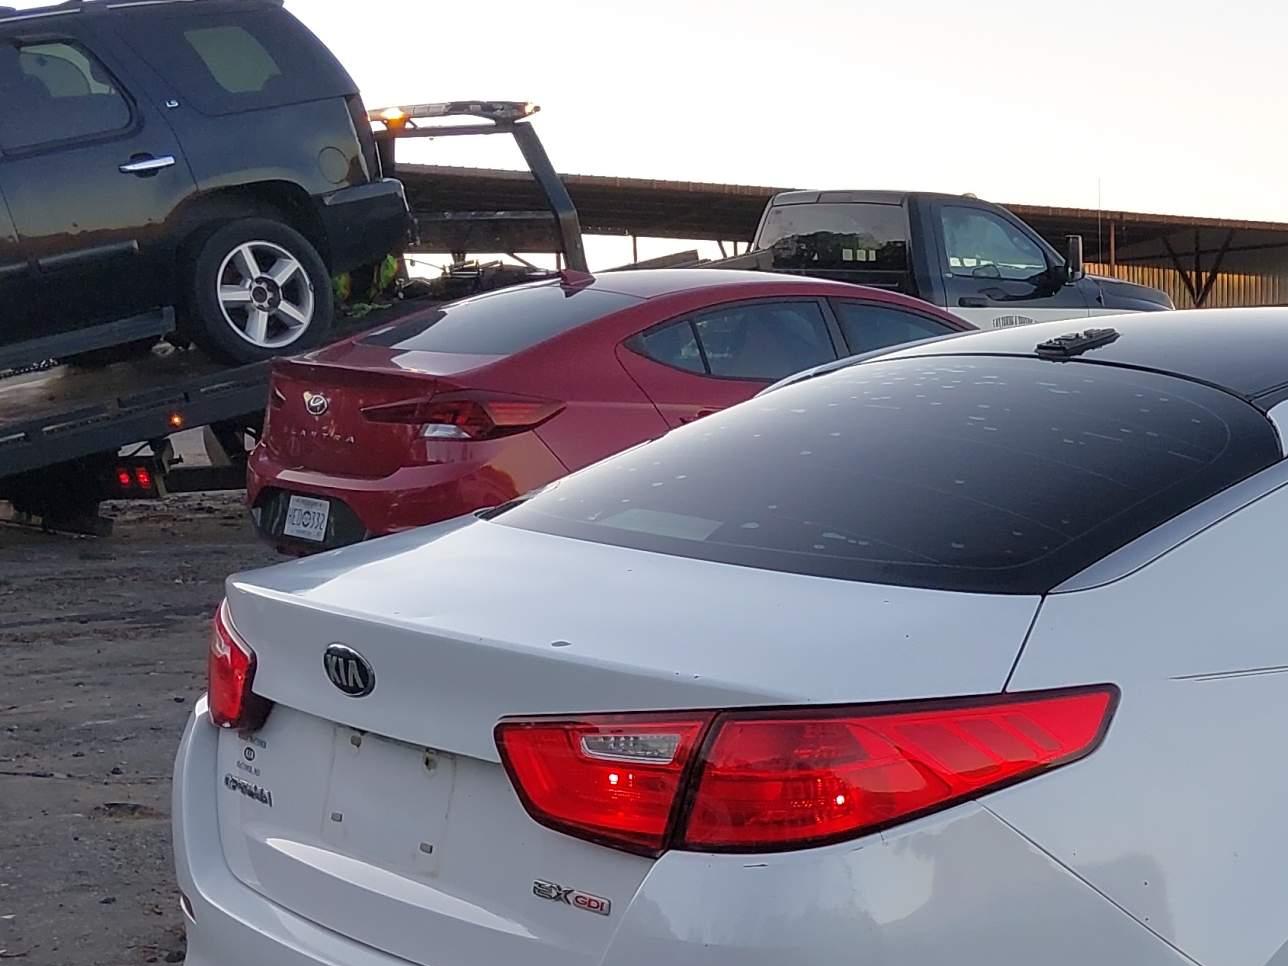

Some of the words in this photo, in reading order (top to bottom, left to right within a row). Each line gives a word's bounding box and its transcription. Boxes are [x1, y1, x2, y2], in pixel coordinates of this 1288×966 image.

[325, 652, 366, 690] KIA
[532, 879, 573, 905] EX
[574, 895, 606, 912] GDI
